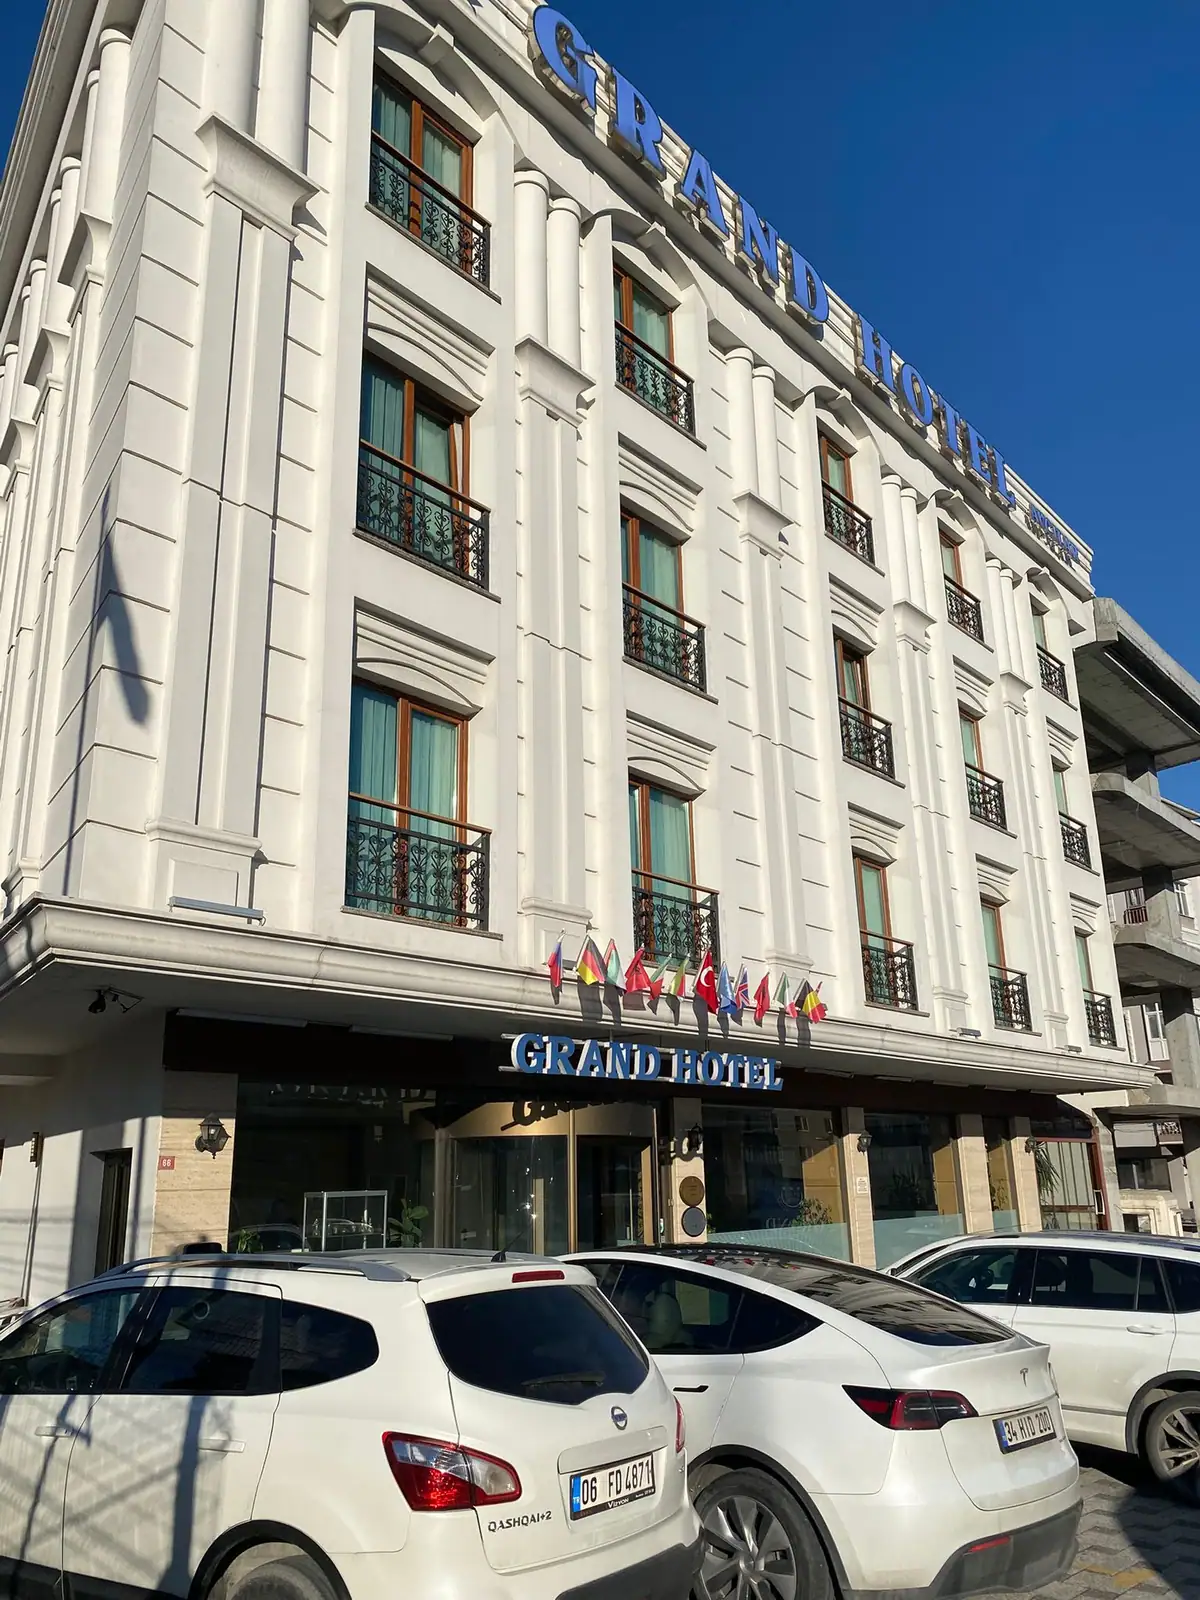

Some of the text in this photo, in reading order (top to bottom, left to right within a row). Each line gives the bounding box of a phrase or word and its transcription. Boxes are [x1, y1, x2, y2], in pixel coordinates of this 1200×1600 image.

[531, 4, 1017, 508] GRAND HOTEL
[511, 1032, 784, 1091] GRAND HOTEL
[1004, 1411, 1051, 1442] 34 HID 200
[581, 1459, 651, 1505] 06 FD 4871
[488, 1510, 552, 1532] QASHQAI+2
